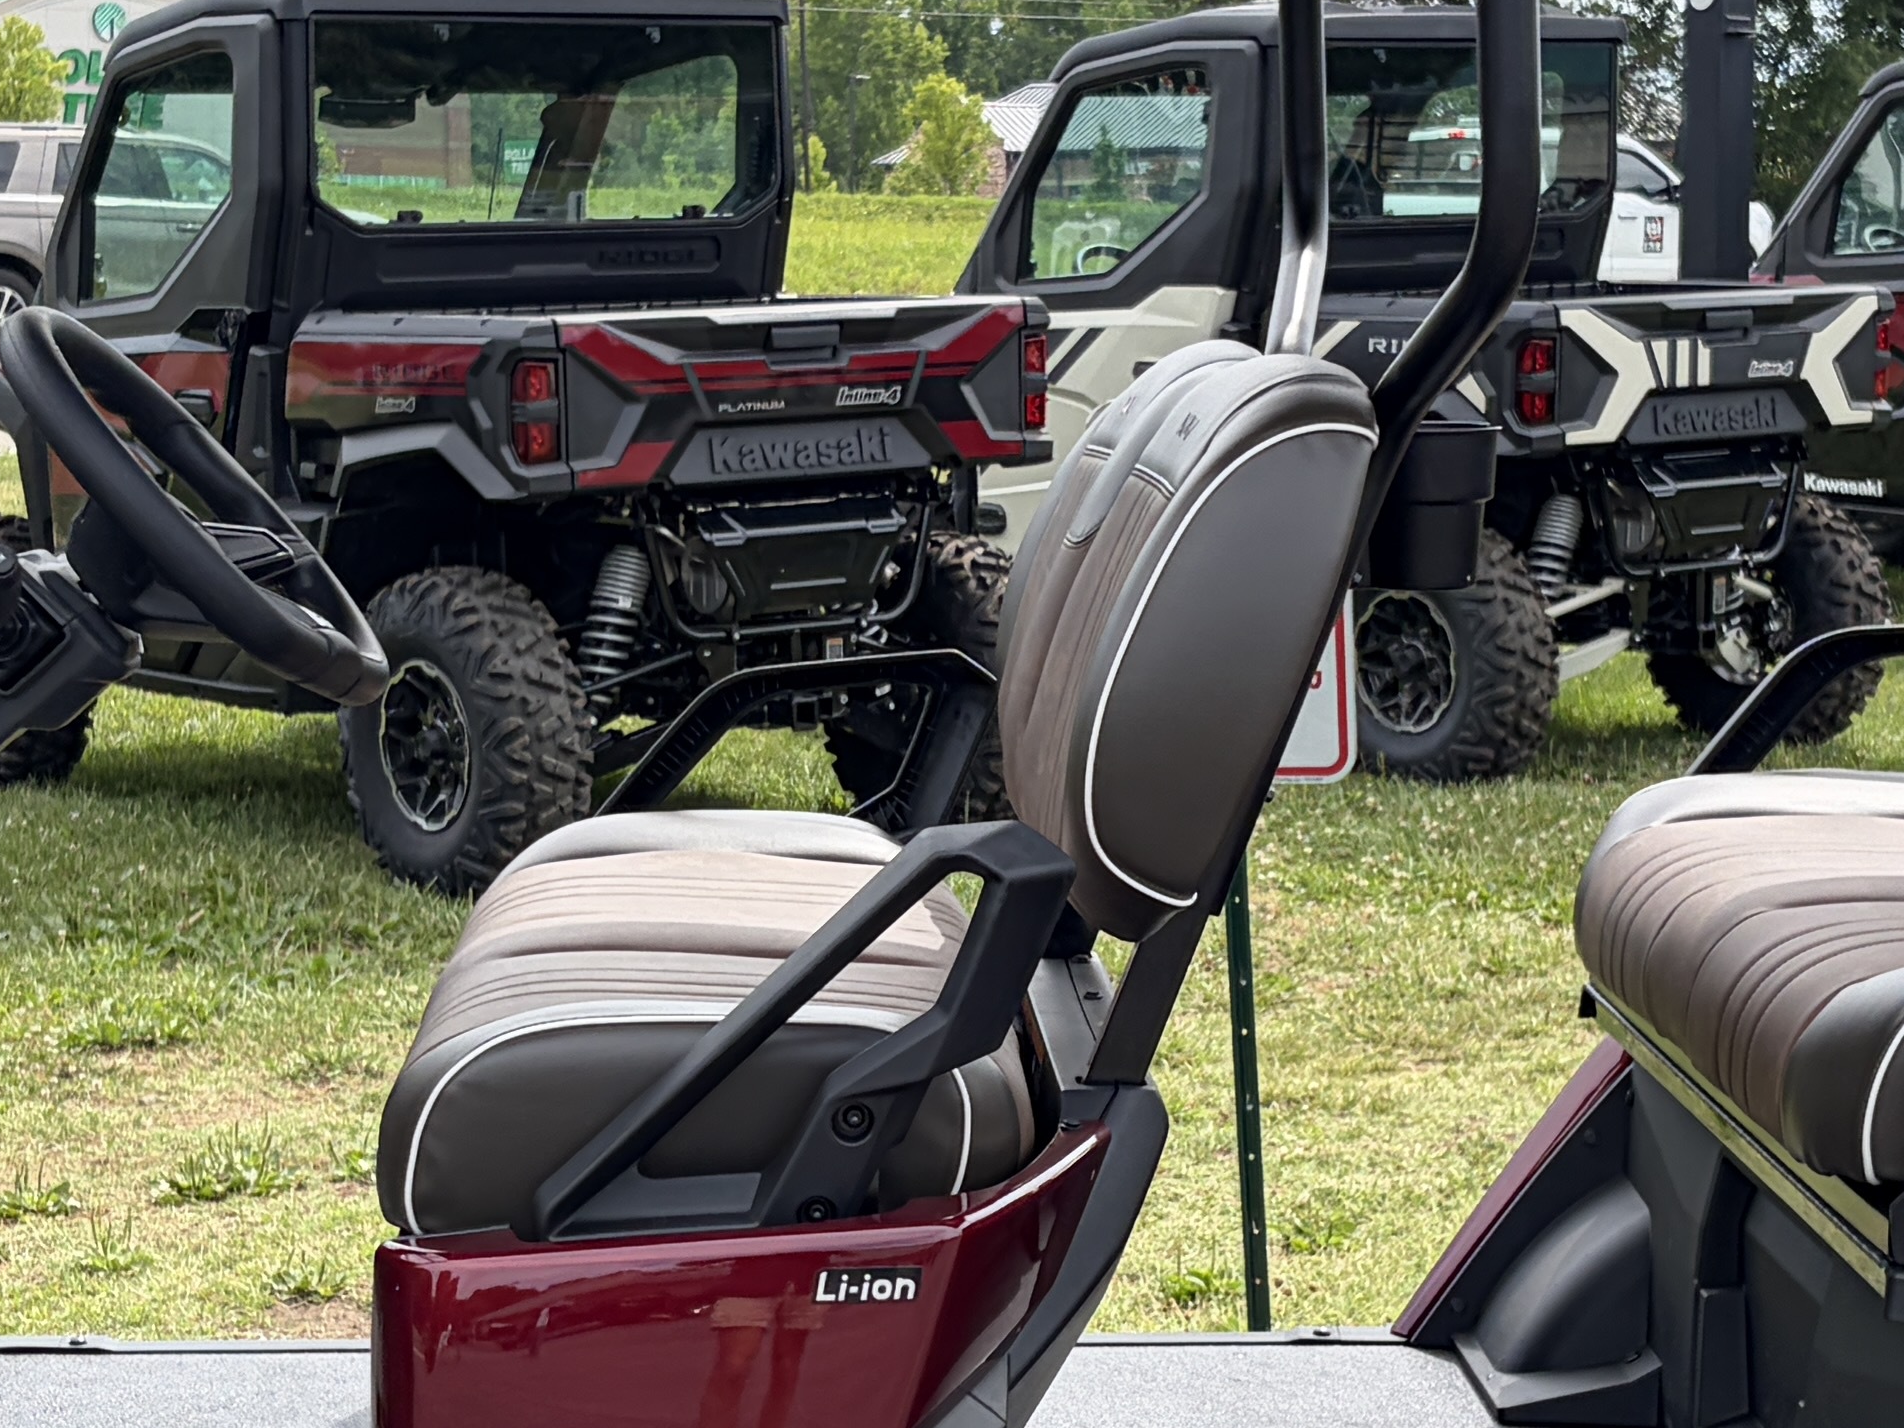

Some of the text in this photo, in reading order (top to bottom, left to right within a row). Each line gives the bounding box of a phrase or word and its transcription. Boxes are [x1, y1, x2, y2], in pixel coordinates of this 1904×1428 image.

[718, 400, 786, 413] PLATINUM
[1652, 395, 1778, 437] Kawasaki
[708, 425, 892, 474] Kawasaki
[1803, 472, 1883, 498] Kawasaki
[816, 1271, 916, 1302] Li-ion
